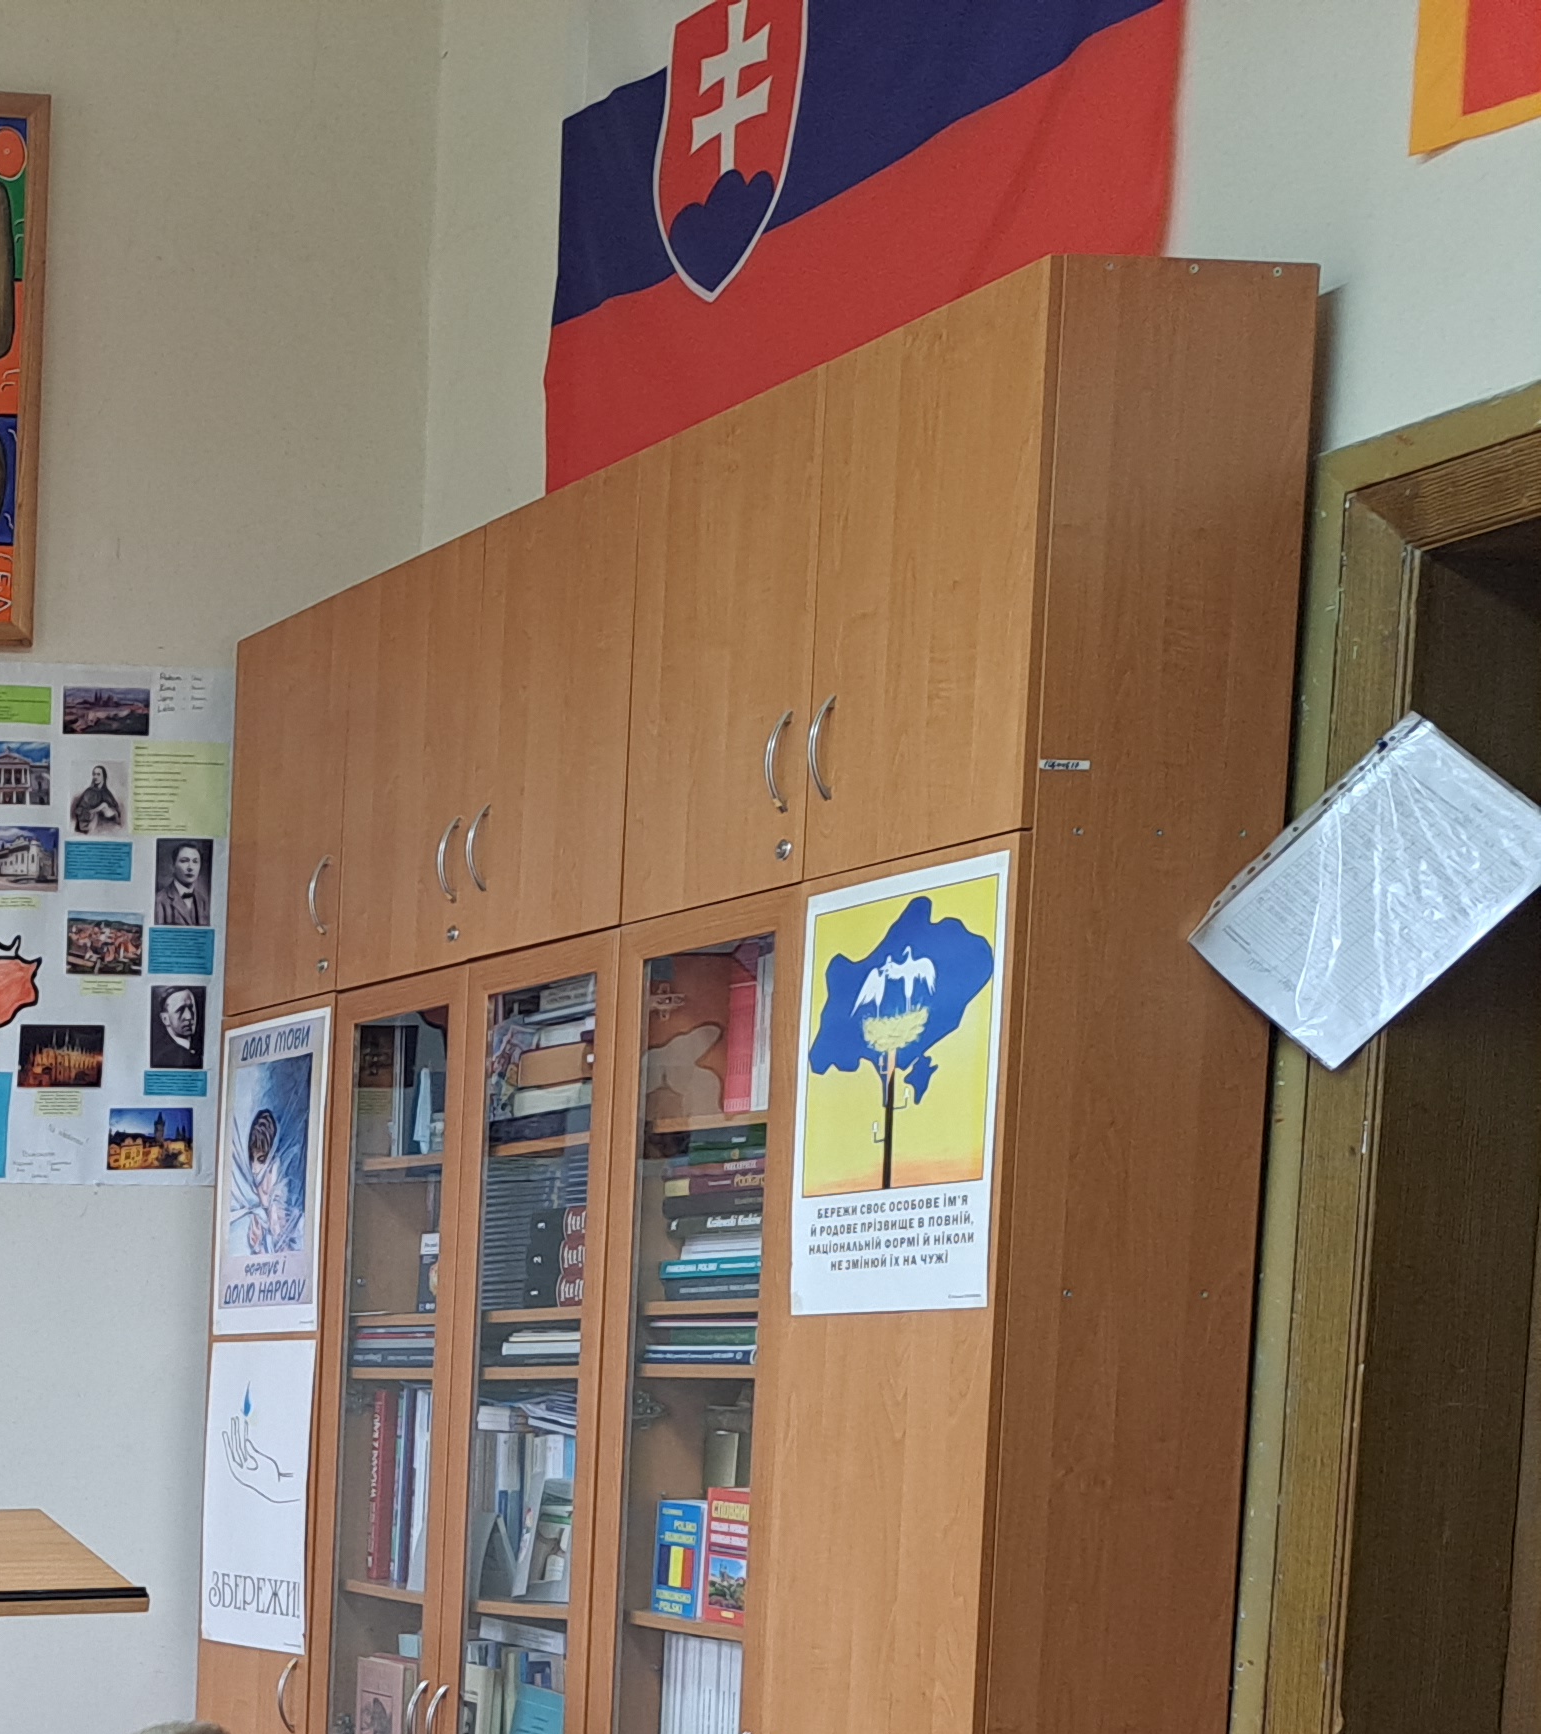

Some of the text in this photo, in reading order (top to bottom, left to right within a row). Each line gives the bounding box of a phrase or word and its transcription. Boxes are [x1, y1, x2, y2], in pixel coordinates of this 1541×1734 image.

[240, 1024, 311, 1062] ДОЛЯ МОВИ
[817, 1206, 858, 1219] БЕРЕЖИ
[860, 1202, 886, 1215] СВОЄ
[889, 1197, 939, 1212] ОСОБОВЕ
[810, 1225, 817, 1237] Й
[819, 1222, 858, 1236] РОДОВЕ
[860, 1217, 915, 1233] ПРІЗВИЩЕ
[917, 1217, 925, 1228] В
[808, 1231, 974, 1255] НАЦІОНАЛЬНІЙ ФОРМІ Й НІКОЛИ
[533, 1256, 542, 1264] 2
[830, 1249, 948, 1271] НЕ ЗМІНЮЙ ЇХ НА ЧУЖІ
[223, 1278, 306, 1305] ДОЛЮ НАРОДУ
[208, 1570, 301, 1619] ЗБЕРЕЖИ!
